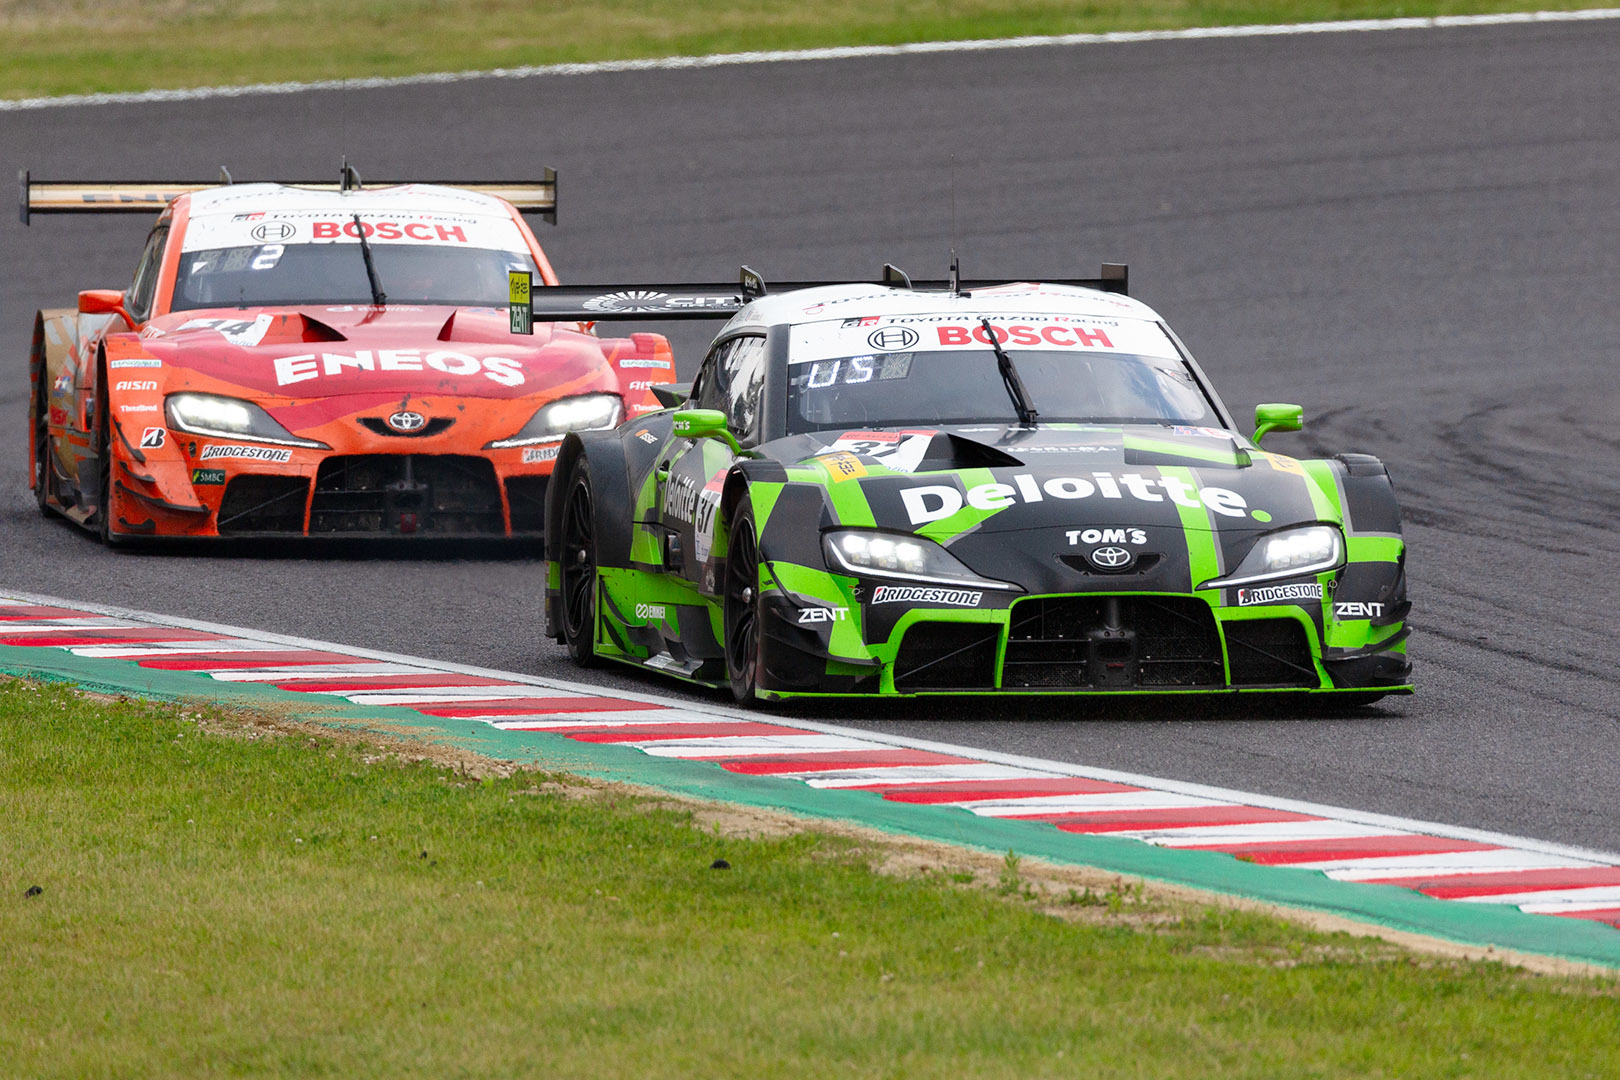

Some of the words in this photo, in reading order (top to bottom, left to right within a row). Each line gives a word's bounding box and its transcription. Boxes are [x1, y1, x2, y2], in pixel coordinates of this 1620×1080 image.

[313, 221, 468, 242] BOSCH
[251, 245, 286, 270] 2
[889, 316, 968, 324] TOYOTA
[1054, 317, 1119, 327] Racing
[936, 325, 1115, 348] BOSCH
[273, 350, 525, 386] ENEOS
[116, 381, 157, 390] AISIN
[202, 446, 291, 461] BRIDGESTONE
[200, 472, 224, 482] SMBC
[1065, 528, 1148, 545] TOM'S
[873, 586, 982, 605] BRIDGESTONE
[1240, 585, 1322, 606] BRIDGESTONE
[798, 607, 849, 623] ZENT
[1334, 602, 1385, 617] ZENT
